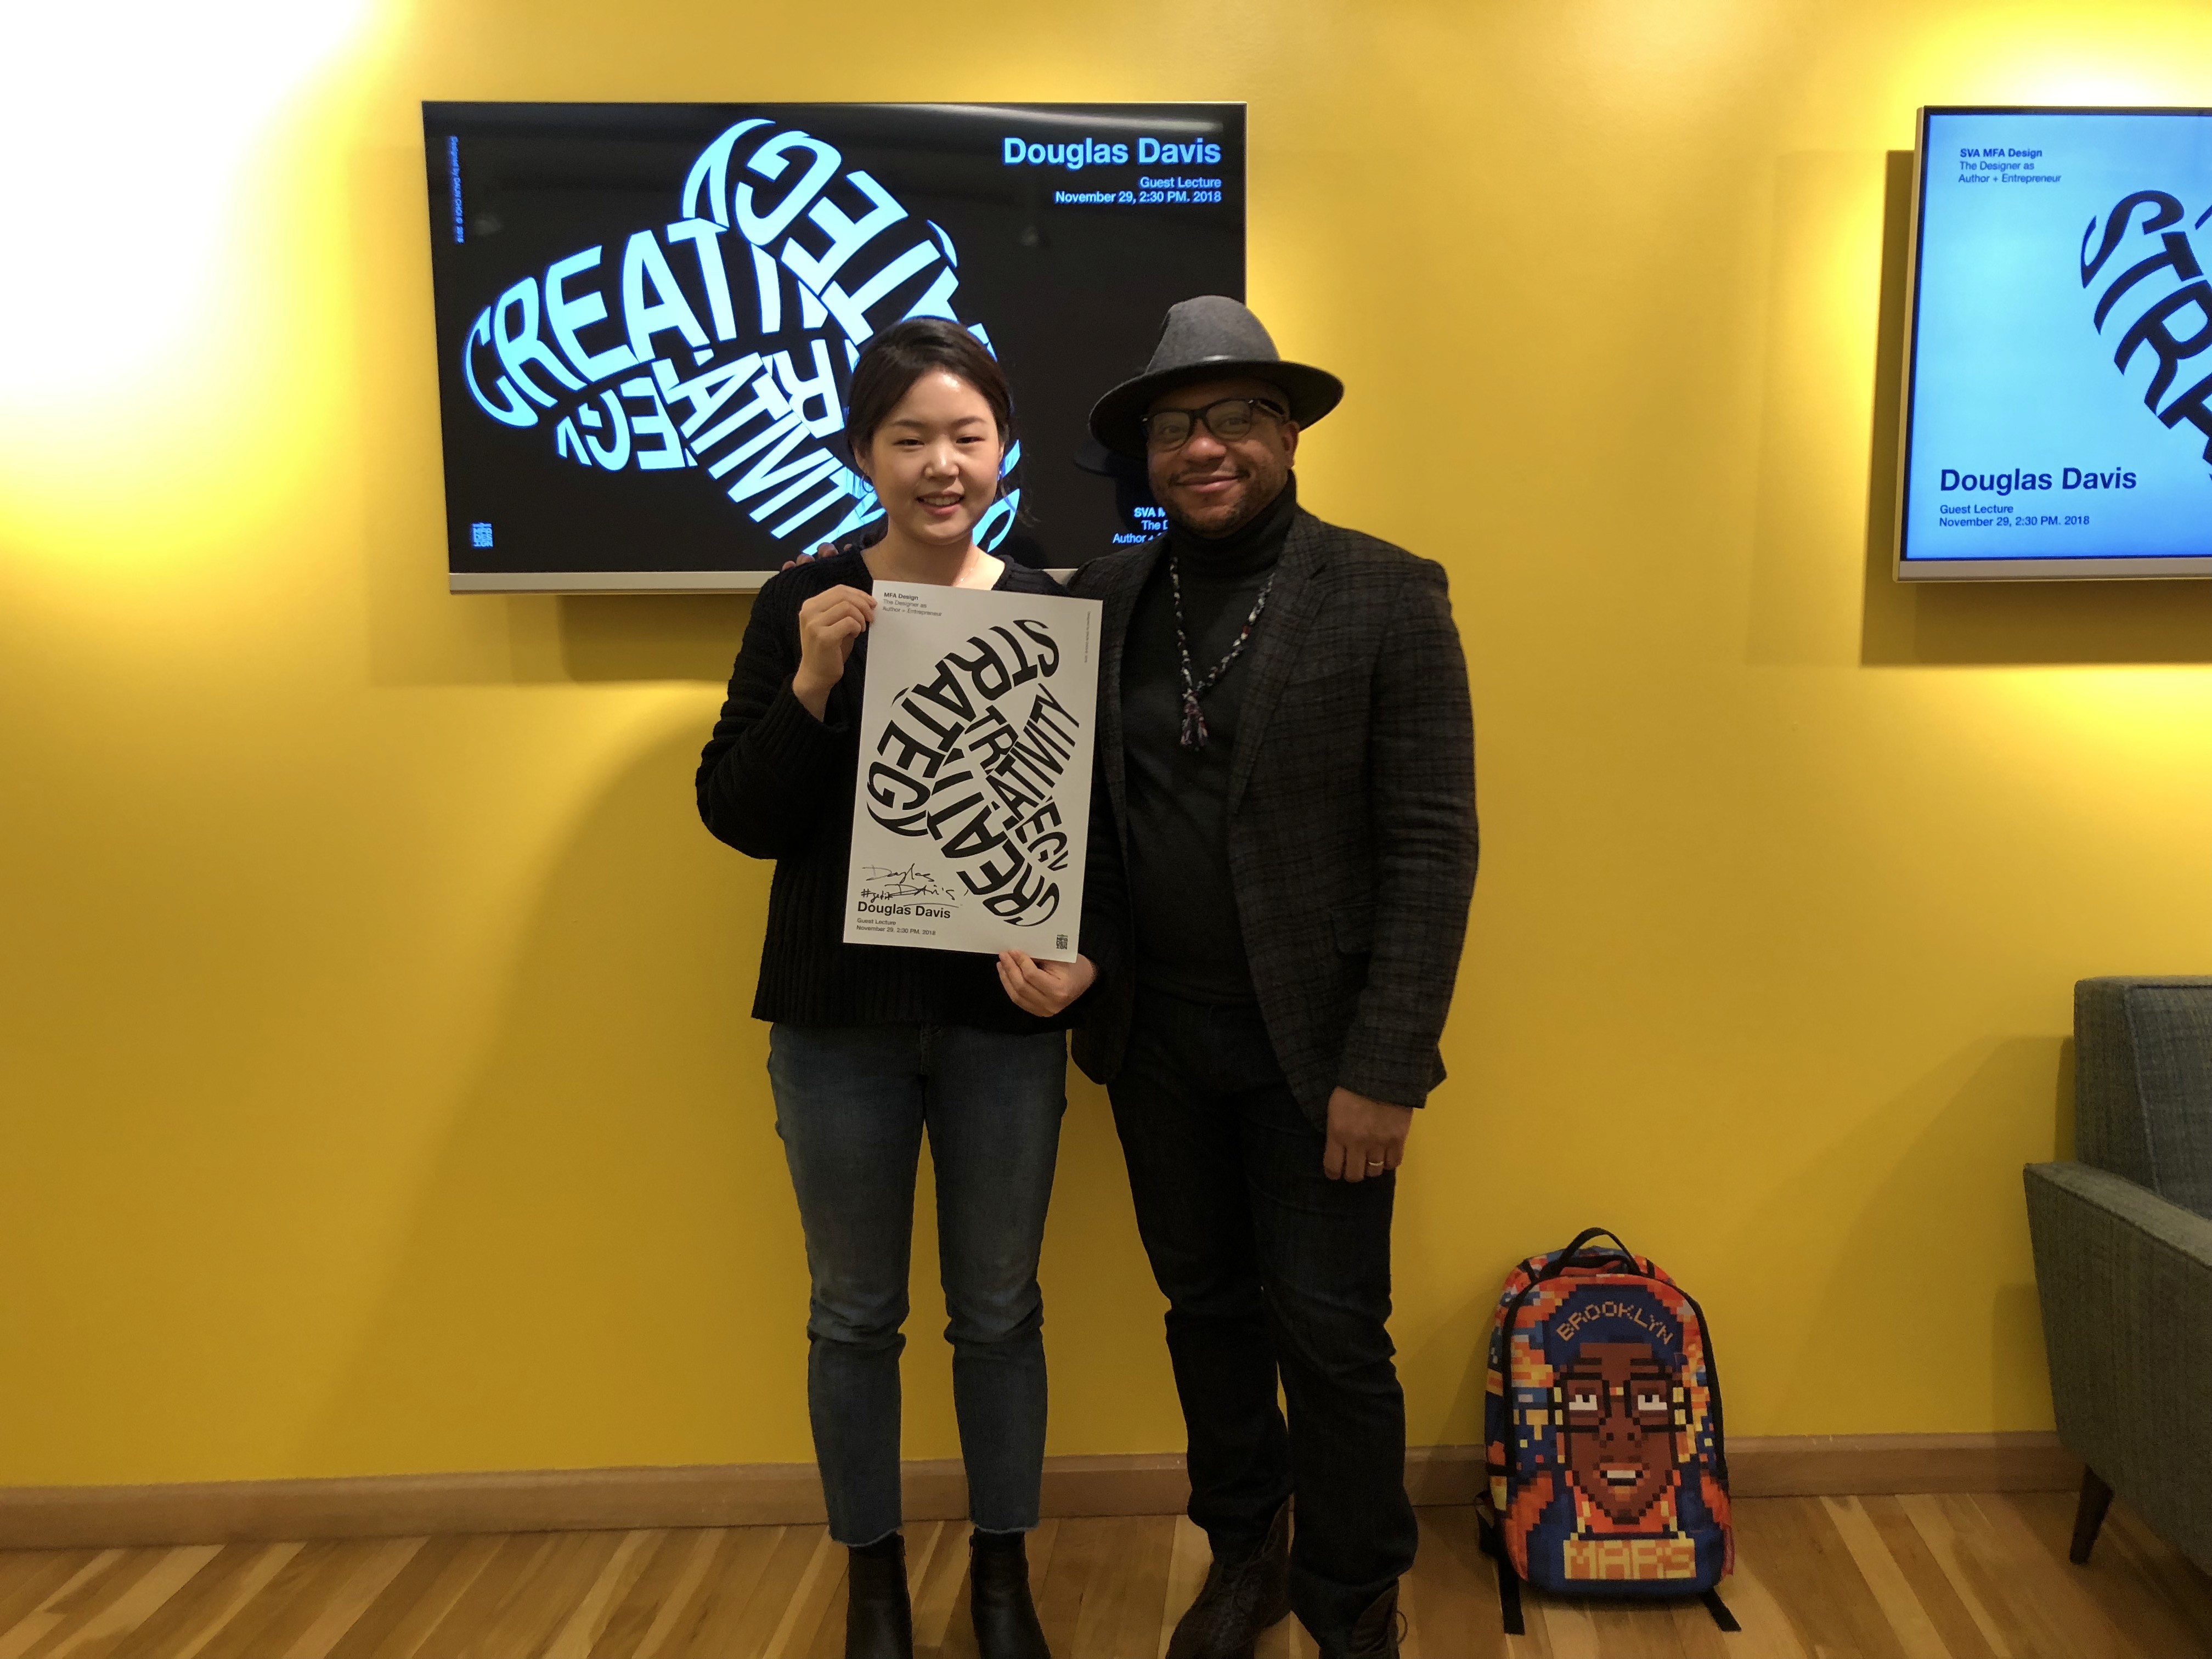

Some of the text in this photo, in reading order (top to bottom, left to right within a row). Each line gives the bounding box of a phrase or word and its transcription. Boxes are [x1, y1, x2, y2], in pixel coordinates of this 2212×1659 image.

[1004, 137, 1221, 170] Douglas Davis
[1960, 148, 2042, 159] SVA MFA Design
[1959, 161, 1977, 170] The
[1979, 161, 2021, 172] Designer
[1140, 177, 1222, 189] Guest Lecture
[1958, 174, 1990, 183] Author
[2001, 173, 2062, 184] Entrepreneur
[1055, 191, 1222, 205] November 29, 2:30 PM. 2018
[1940, 467, 2137, 496] Douglas Davis
[1133, 506, 1156, 518] SVA
[1939, 504, 2014, 514] Guest Lecture
[1141, 520, 1161, 531] The
[1939, 516, 2090, 527] November 29, 2:30 PM. 2018
[1112, 533, 1147, 544] Author
[907, 608, 943, 617] Entrepreneur
[857, 901, 951, 919] Douglas Davis
[1556, 1300, 1674, 1346] BROOKLYN
